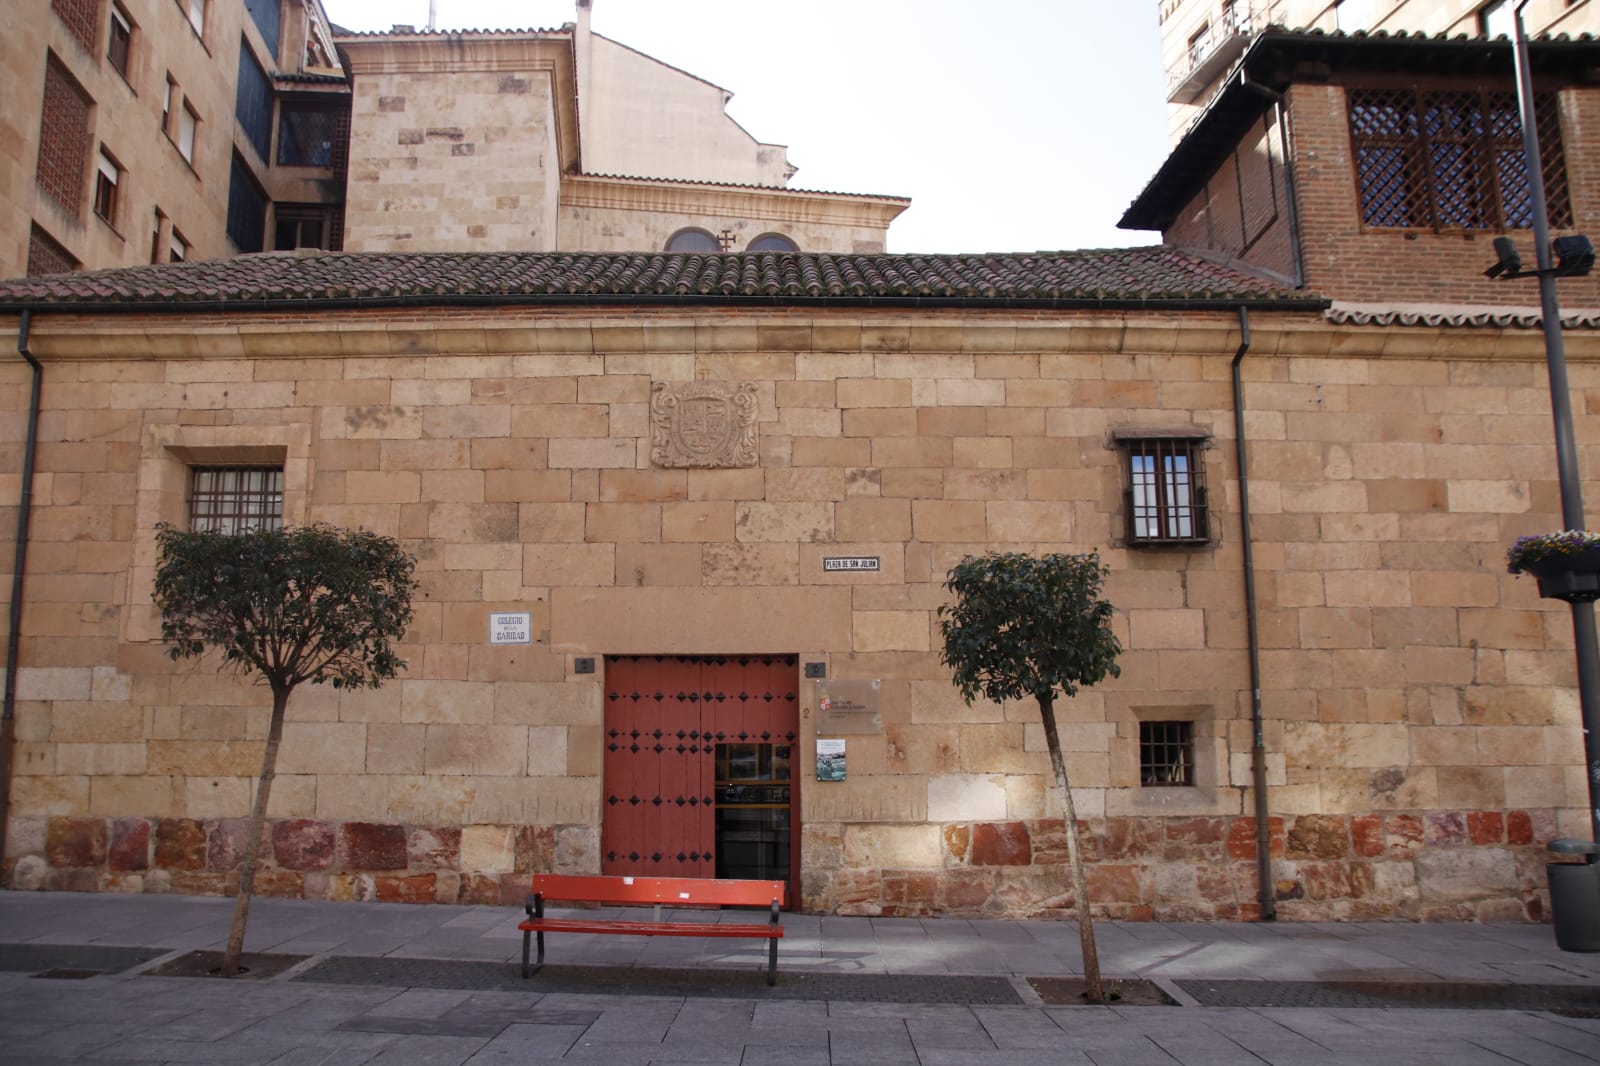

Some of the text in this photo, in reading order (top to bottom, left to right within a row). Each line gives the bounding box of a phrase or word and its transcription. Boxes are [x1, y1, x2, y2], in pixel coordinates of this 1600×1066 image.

[826, 560, 841, 568] PLAZA
[498, 616, 523, 624] COLEGIO
[496, 632, 524, 640] CARIDAD
[803, 707, 810, 718] 2
